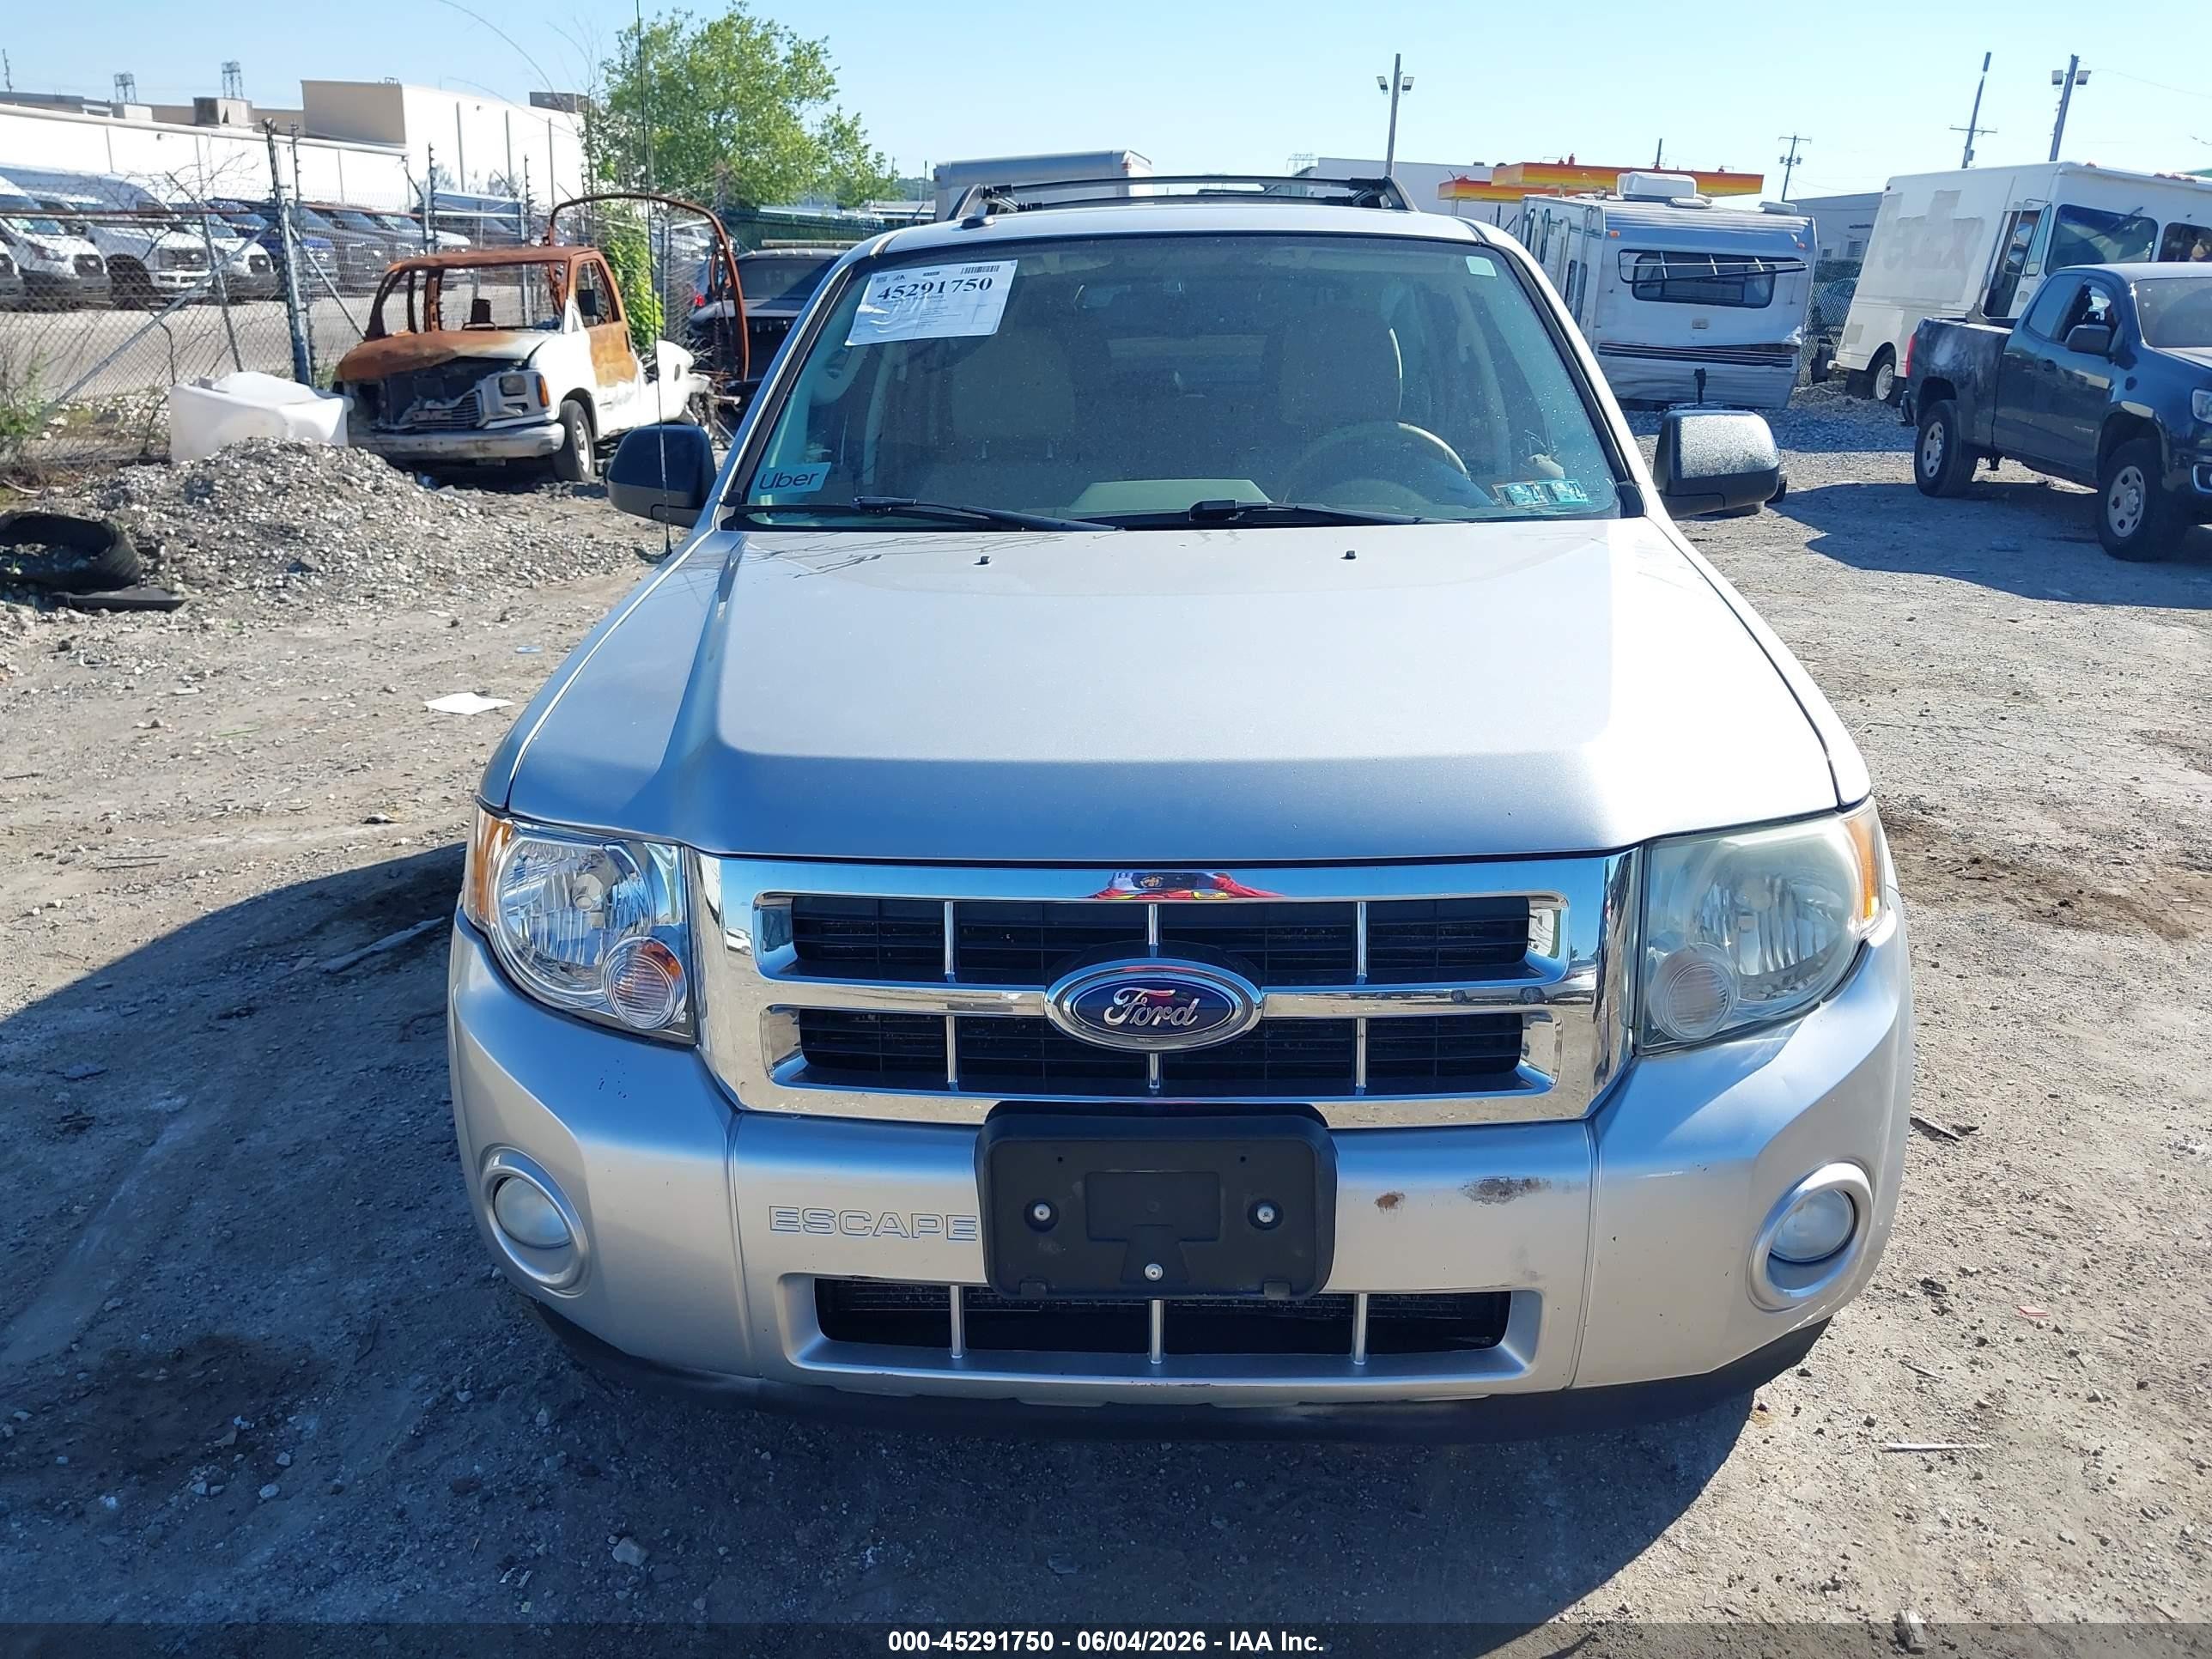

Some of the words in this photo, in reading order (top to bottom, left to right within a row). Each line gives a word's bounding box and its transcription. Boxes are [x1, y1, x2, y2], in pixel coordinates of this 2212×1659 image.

[878, 276, 994, 301] 45291750
[759, 471, 819, 490] Uber
[1103, 987, 1200, 1027] Ford
[769, 1205, 978, 1242] ESCAPE
